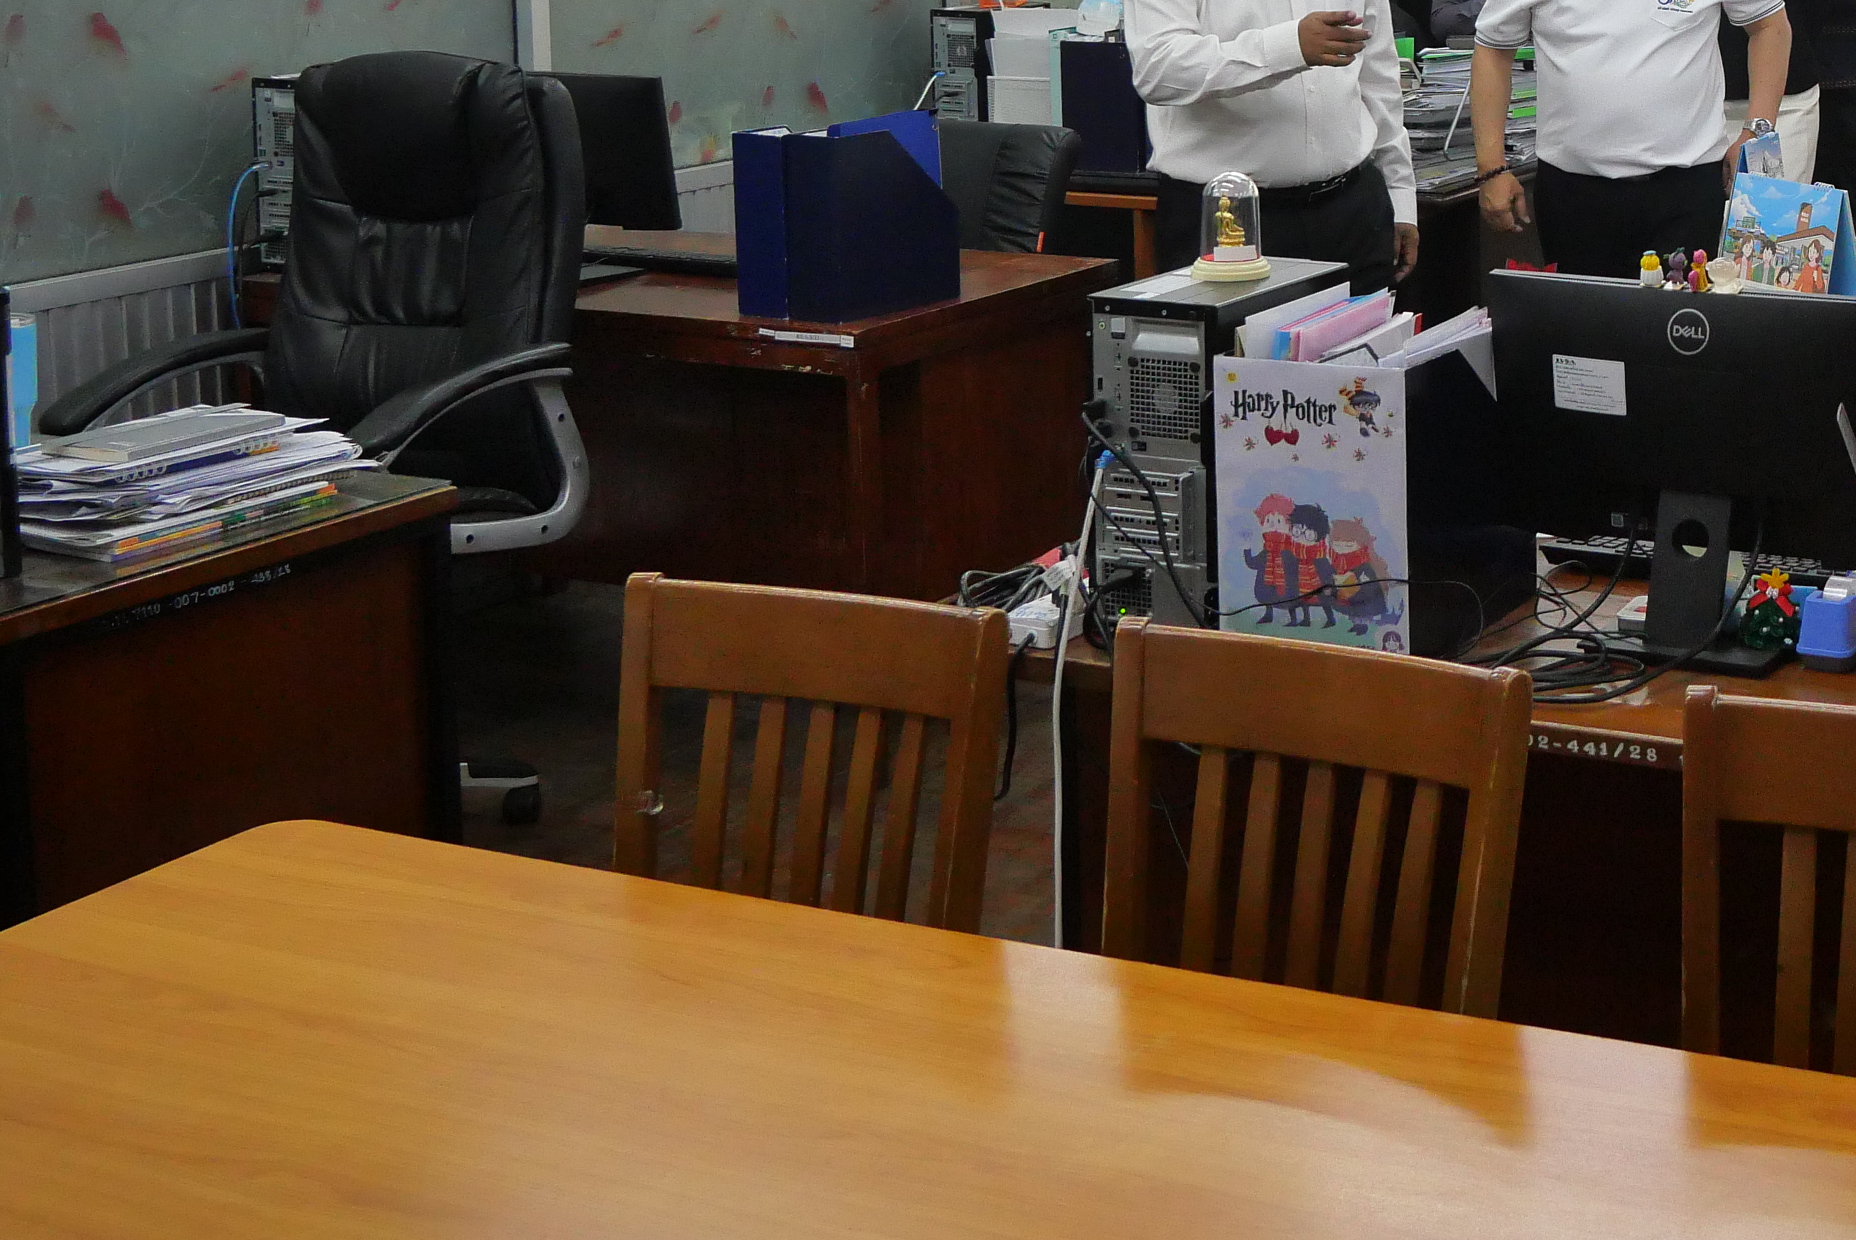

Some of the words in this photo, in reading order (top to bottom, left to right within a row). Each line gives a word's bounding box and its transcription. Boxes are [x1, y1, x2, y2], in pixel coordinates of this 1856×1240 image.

[1672, 324, 1705, 339] DELL
[1230, 389, 1280, 421] Harry
[1281, 388, 1338, 428] Potter
